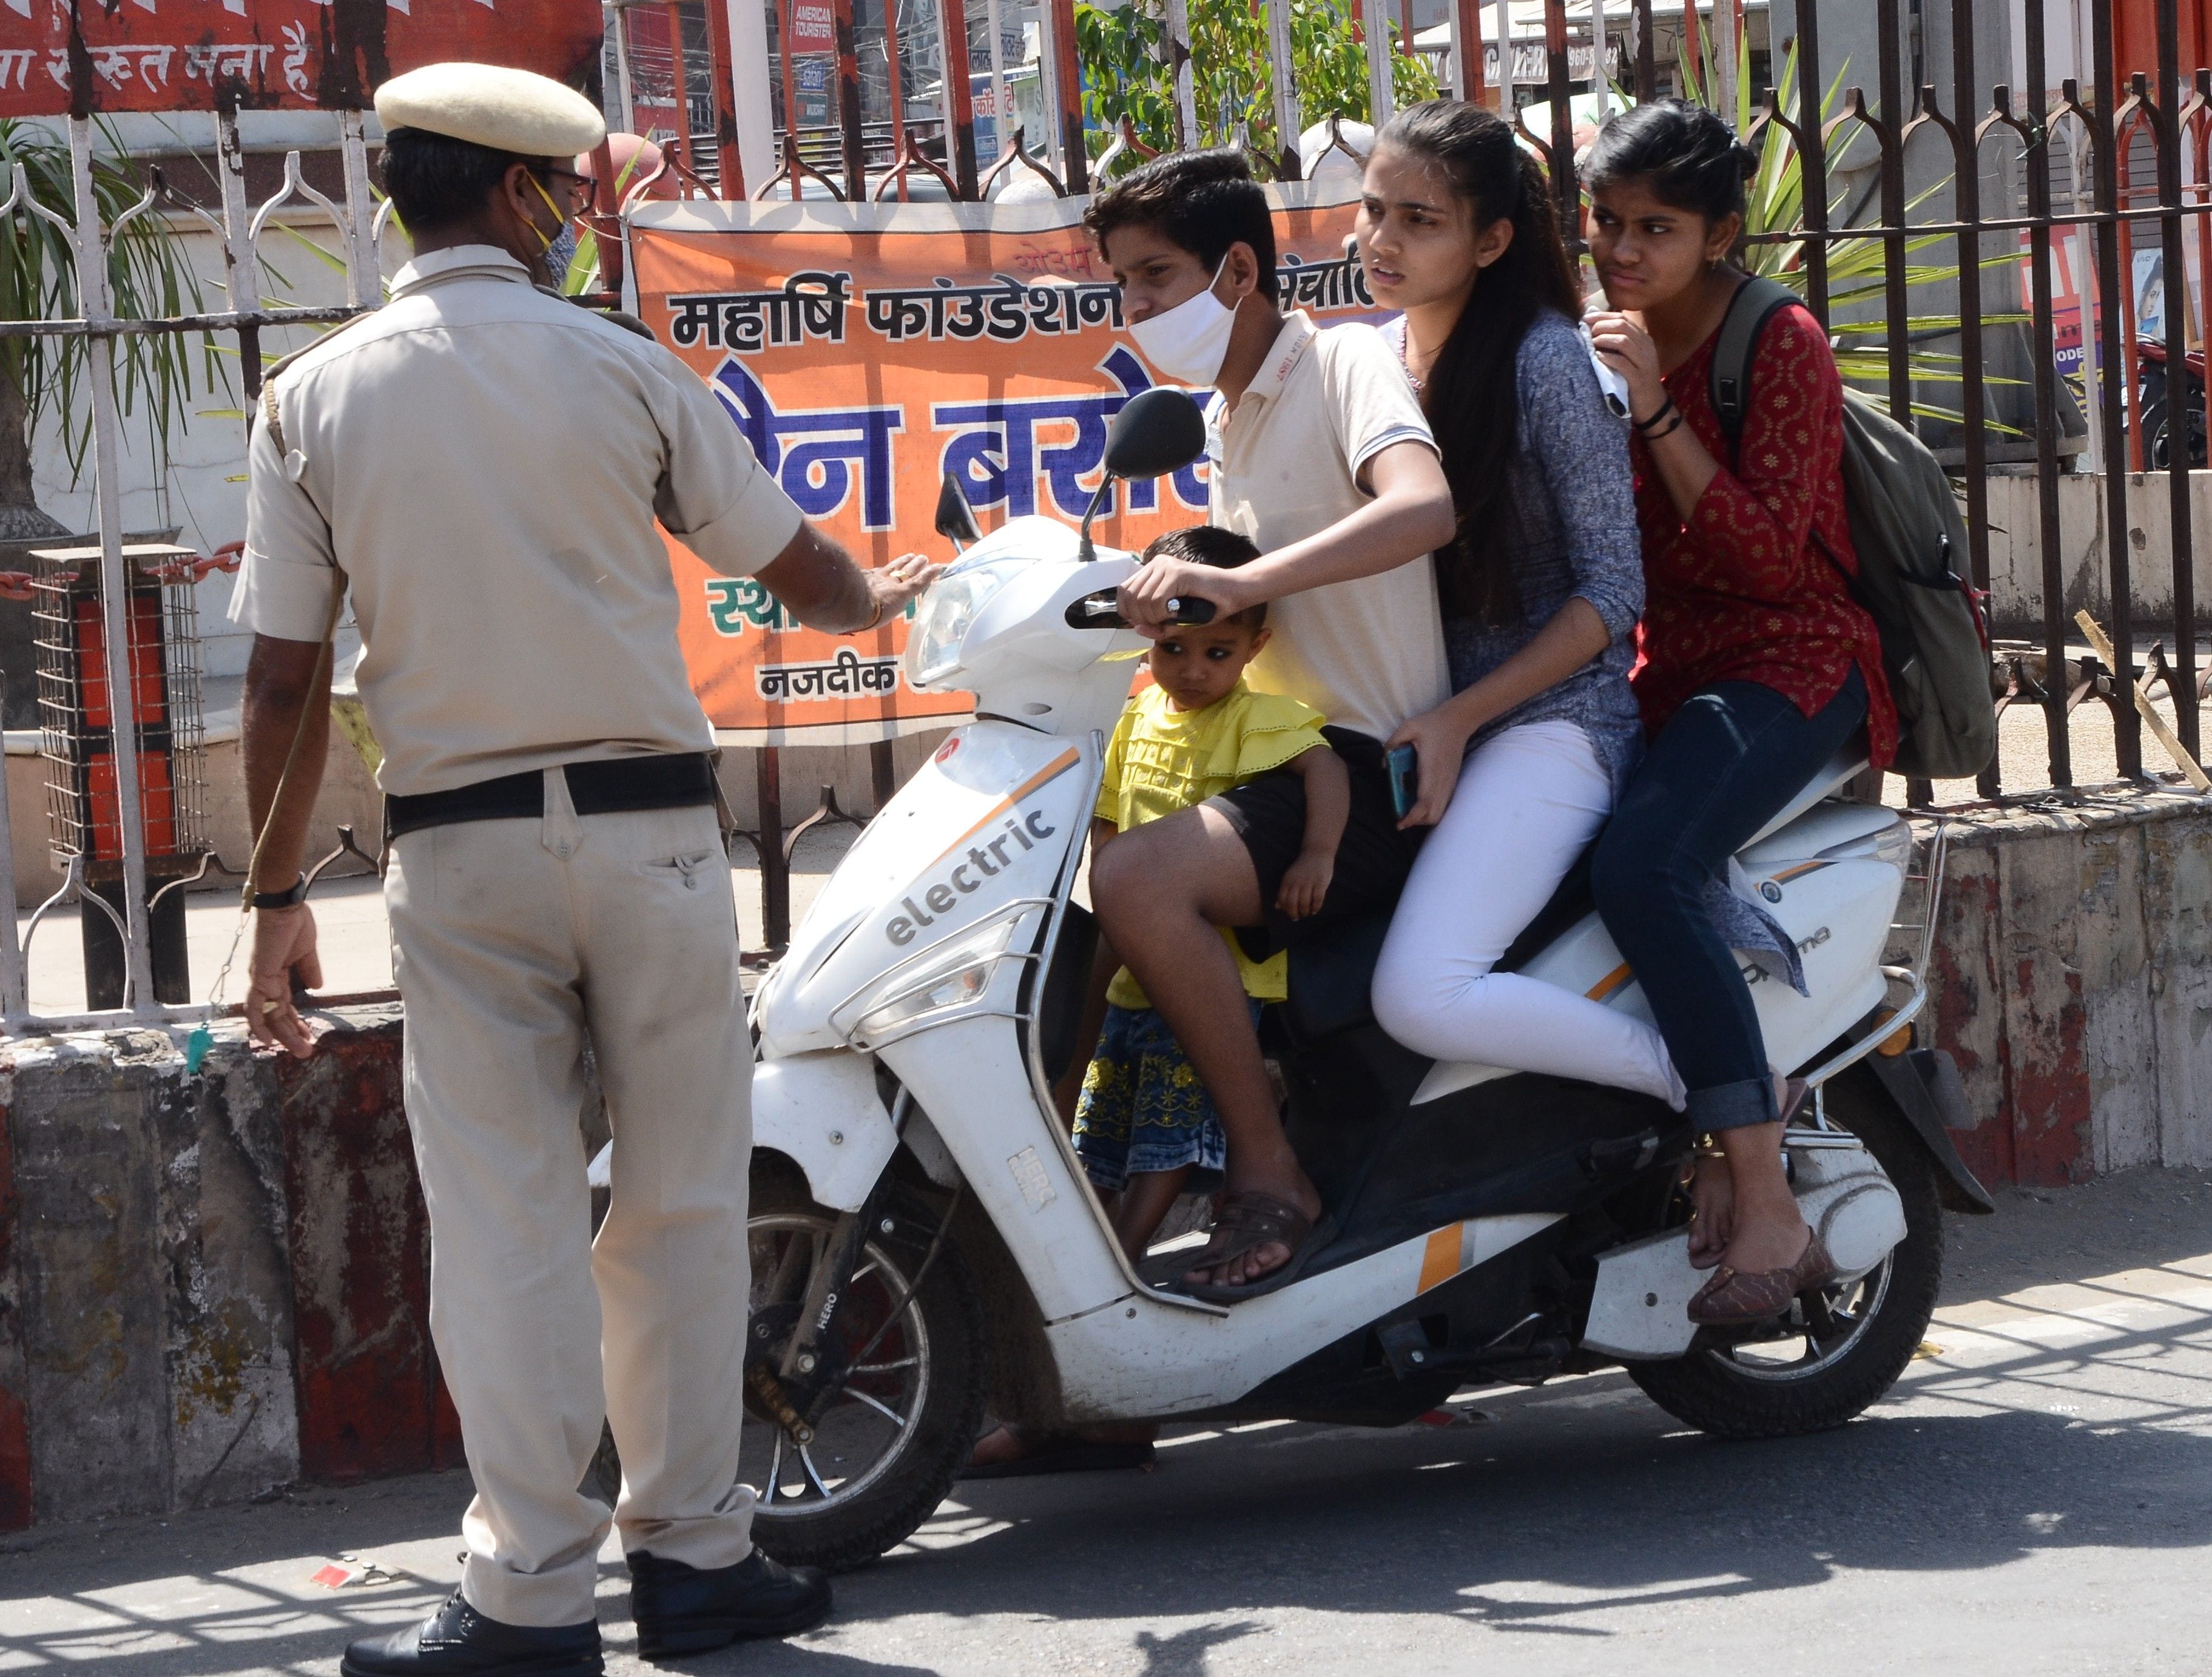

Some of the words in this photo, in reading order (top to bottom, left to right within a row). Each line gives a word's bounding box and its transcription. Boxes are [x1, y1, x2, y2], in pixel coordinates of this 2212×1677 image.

[795, 5, 831, 23] AMERICAN
[795, 21, 832, 38] TOURISTER
[280, 19, 317, 101] है
[758, 649, 899, 700] नजदीक
[885, 810, 1056, 947] electric
[817, 1292, 837, 1330] HERO
